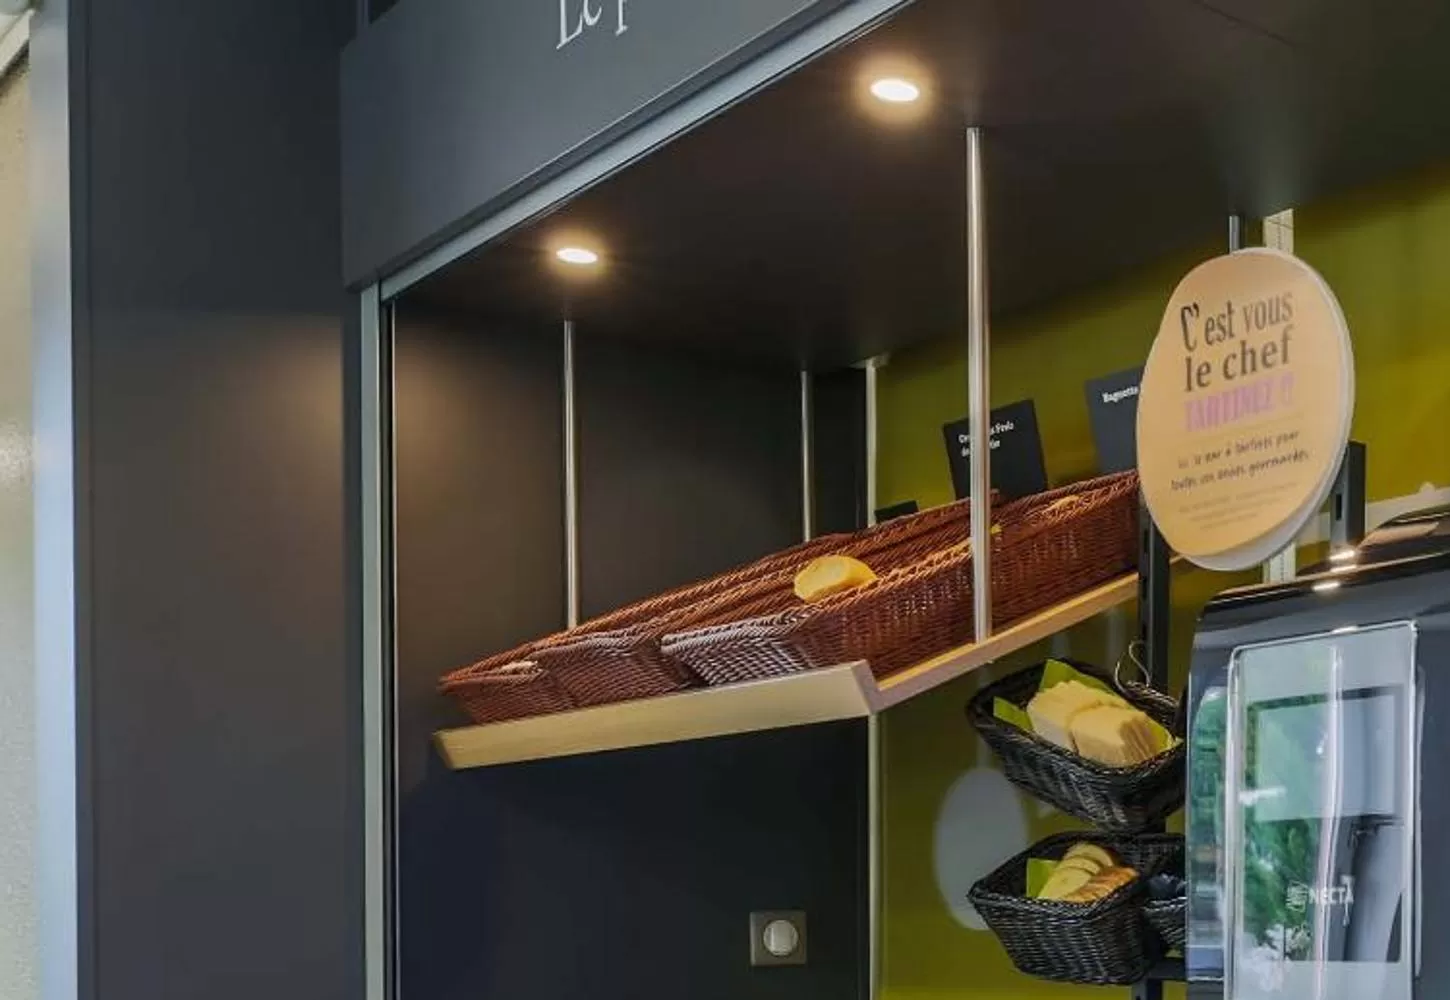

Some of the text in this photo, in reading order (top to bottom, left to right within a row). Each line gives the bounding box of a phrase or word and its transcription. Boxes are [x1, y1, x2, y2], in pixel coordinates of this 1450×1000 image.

[1180, 293, 1294, 352] C'est vous
[1184, 324, 1294, 392] le chef
